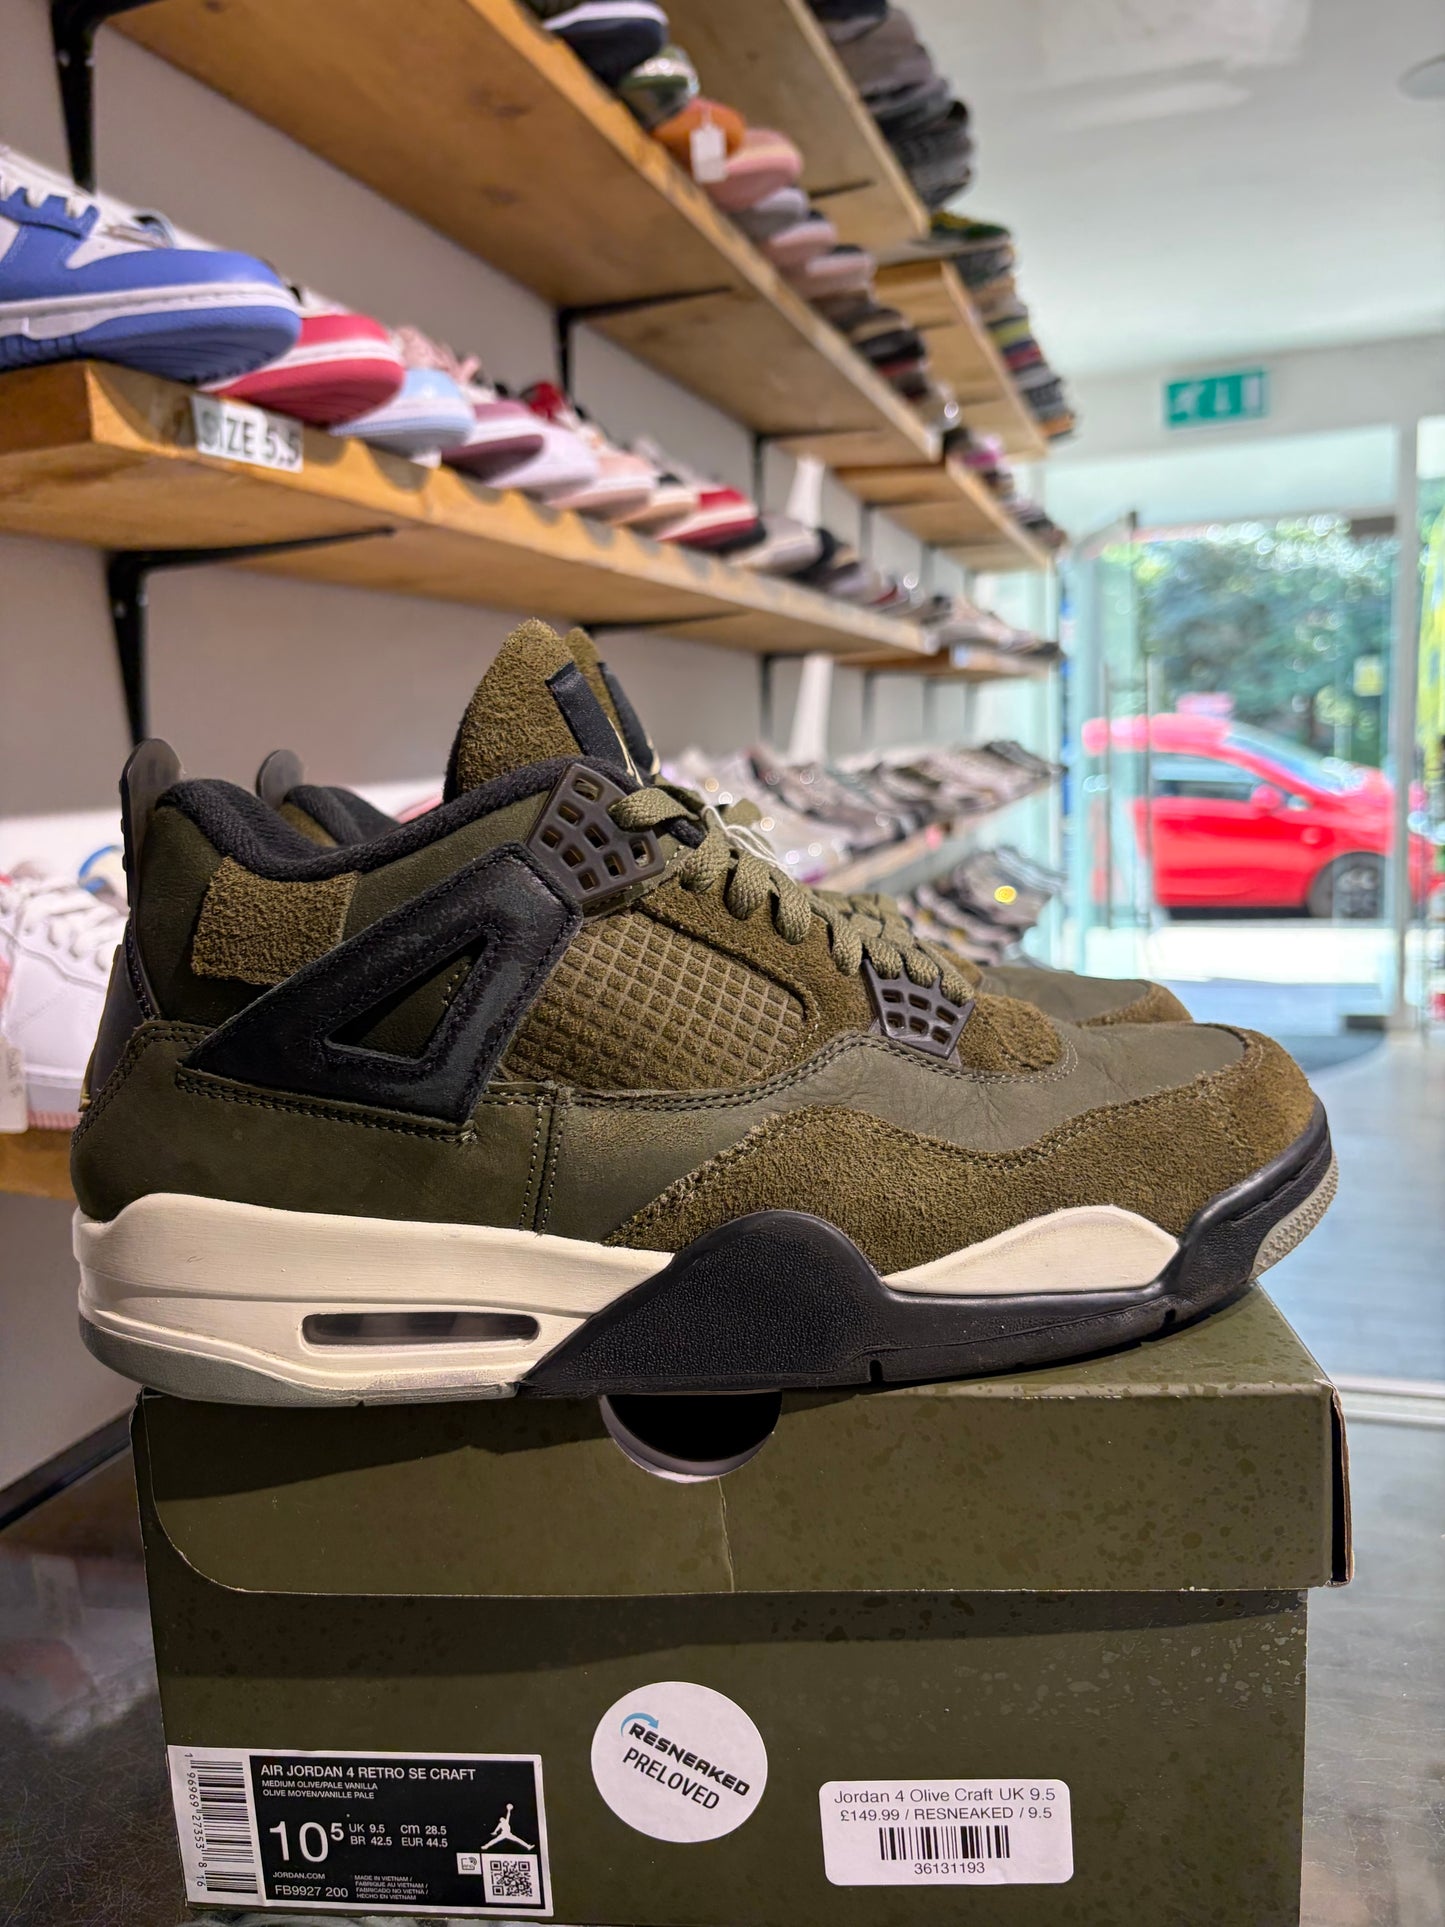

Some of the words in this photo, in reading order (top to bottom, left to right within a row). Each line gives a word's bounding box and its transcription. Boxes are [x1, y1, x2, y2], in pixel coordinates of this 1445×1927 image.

[202, 410, 255, 456] SIZE
[264, 425, 300, 466] 5.5
[628, 1722, 750, 1797] RESNEAKED
[261, 1764, 283, 1776] AIR
[286, 1765, 343, 1778] JORDAN
[346, 1766, 355, 1778] 4
[358, 1767, 405, 1779] RETRO
[408, 1768, 427, 1779] SE
[430, 1768, 476, 1780] CRAFT
[622, 1747, 720, 1809] PRELOVED
[186, 1772, 200, 1807] 96969
[262, 1780, 295, 1788] MEDIUM
[297, 1781, 343, 1789] OLIVE/PALE
[344, 1782, 378, 1790] VANILLA
[263, 1789, 286, 1797] OLIVE
[288, 1790, 352, 1799] MOYEN/VANILLE
[354, 1792, 375, 1800] PALE
[834, 1790, 890, 1804] Jordan
[894, 1790, 905, 1802] 4
[910, 1788, 950, 1802] Olive
[954, 1787, 993, 1801] Craft
[999, 1787, 1024, 1800] UK
[1029, 1786, 1056, 1801] 9.5
[840, 1809, 900, 1821] £149.99
[914, 1807, 1014, 1820] RESNEAKED
[1028, 1807, 1053, 1819] 9.5
[191, 1814, 205, 1849] 27353
[349, 1824, 364, 1833] UK
[369, 1824, 385, 1834] 9.5
[425, 1825, 447, 1835] 28.5
[350, 1836, 366, 1846] BR
[370, 1836, 393, 1846] 42.5
[401, 1837, 423, 1847] EUR
[426, 1837, 448, 1848] 44.5
[272, 1871, 326, 1880] JORDAN.COM
[914, 1862, 985, 1875] 36131193
[275, 1884, 321, 1896] FB9927
[325, 1887, 349, 1898] 200
